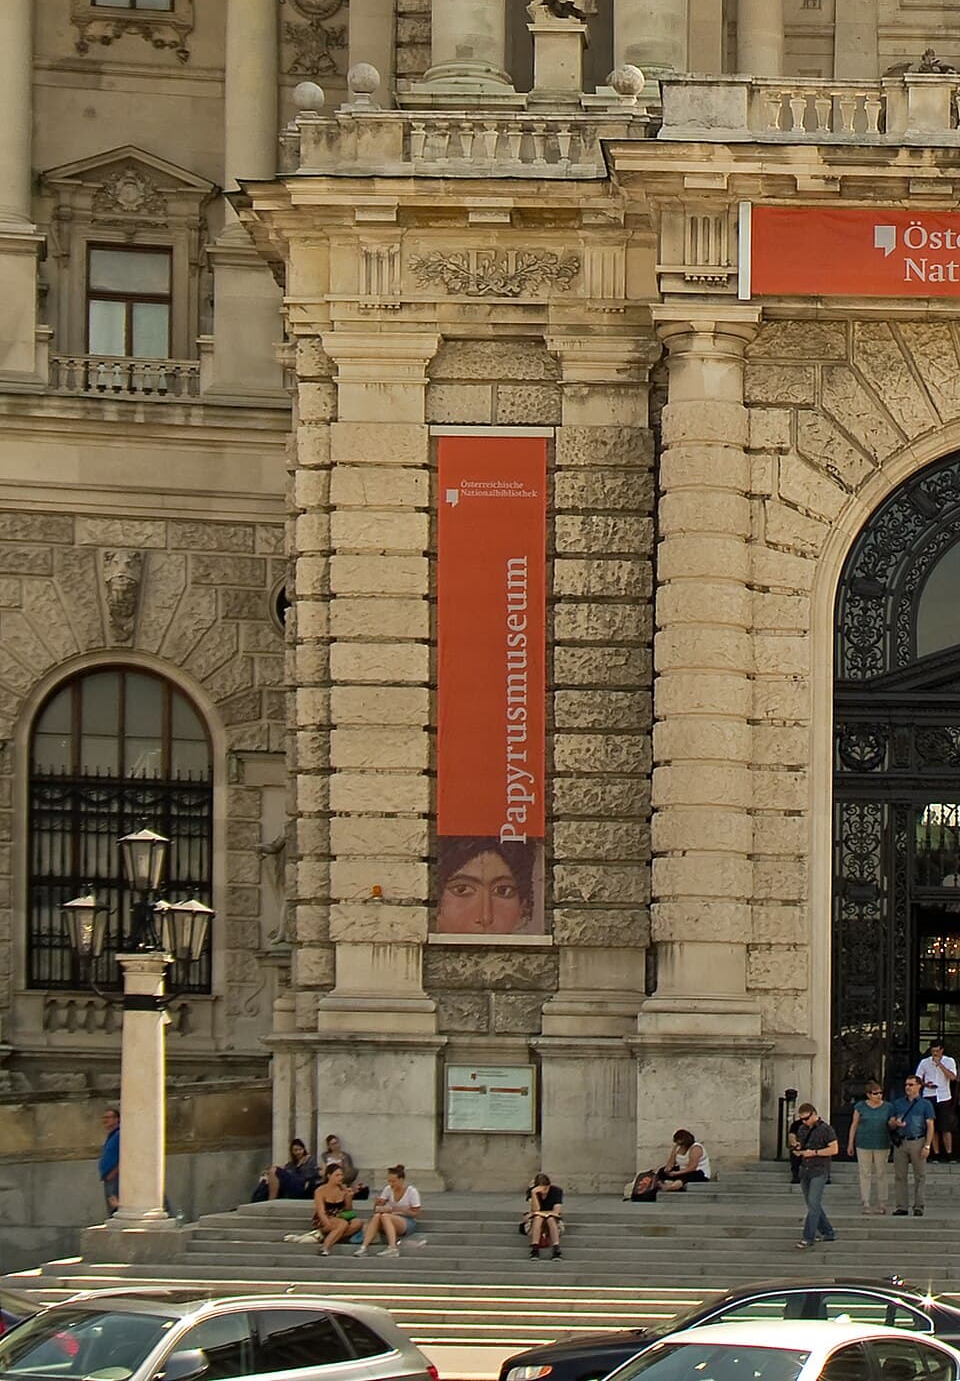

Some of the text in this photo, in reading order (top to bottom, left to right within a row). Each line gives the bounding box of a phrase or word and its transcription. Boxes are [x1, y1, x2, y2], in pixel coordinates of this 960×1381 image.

[460, 479, 524, 489] Österreichische
[460, 488, 538, 498] Nationalbibliothek
[500, 555, 535, 845] Papyrusmuseum
